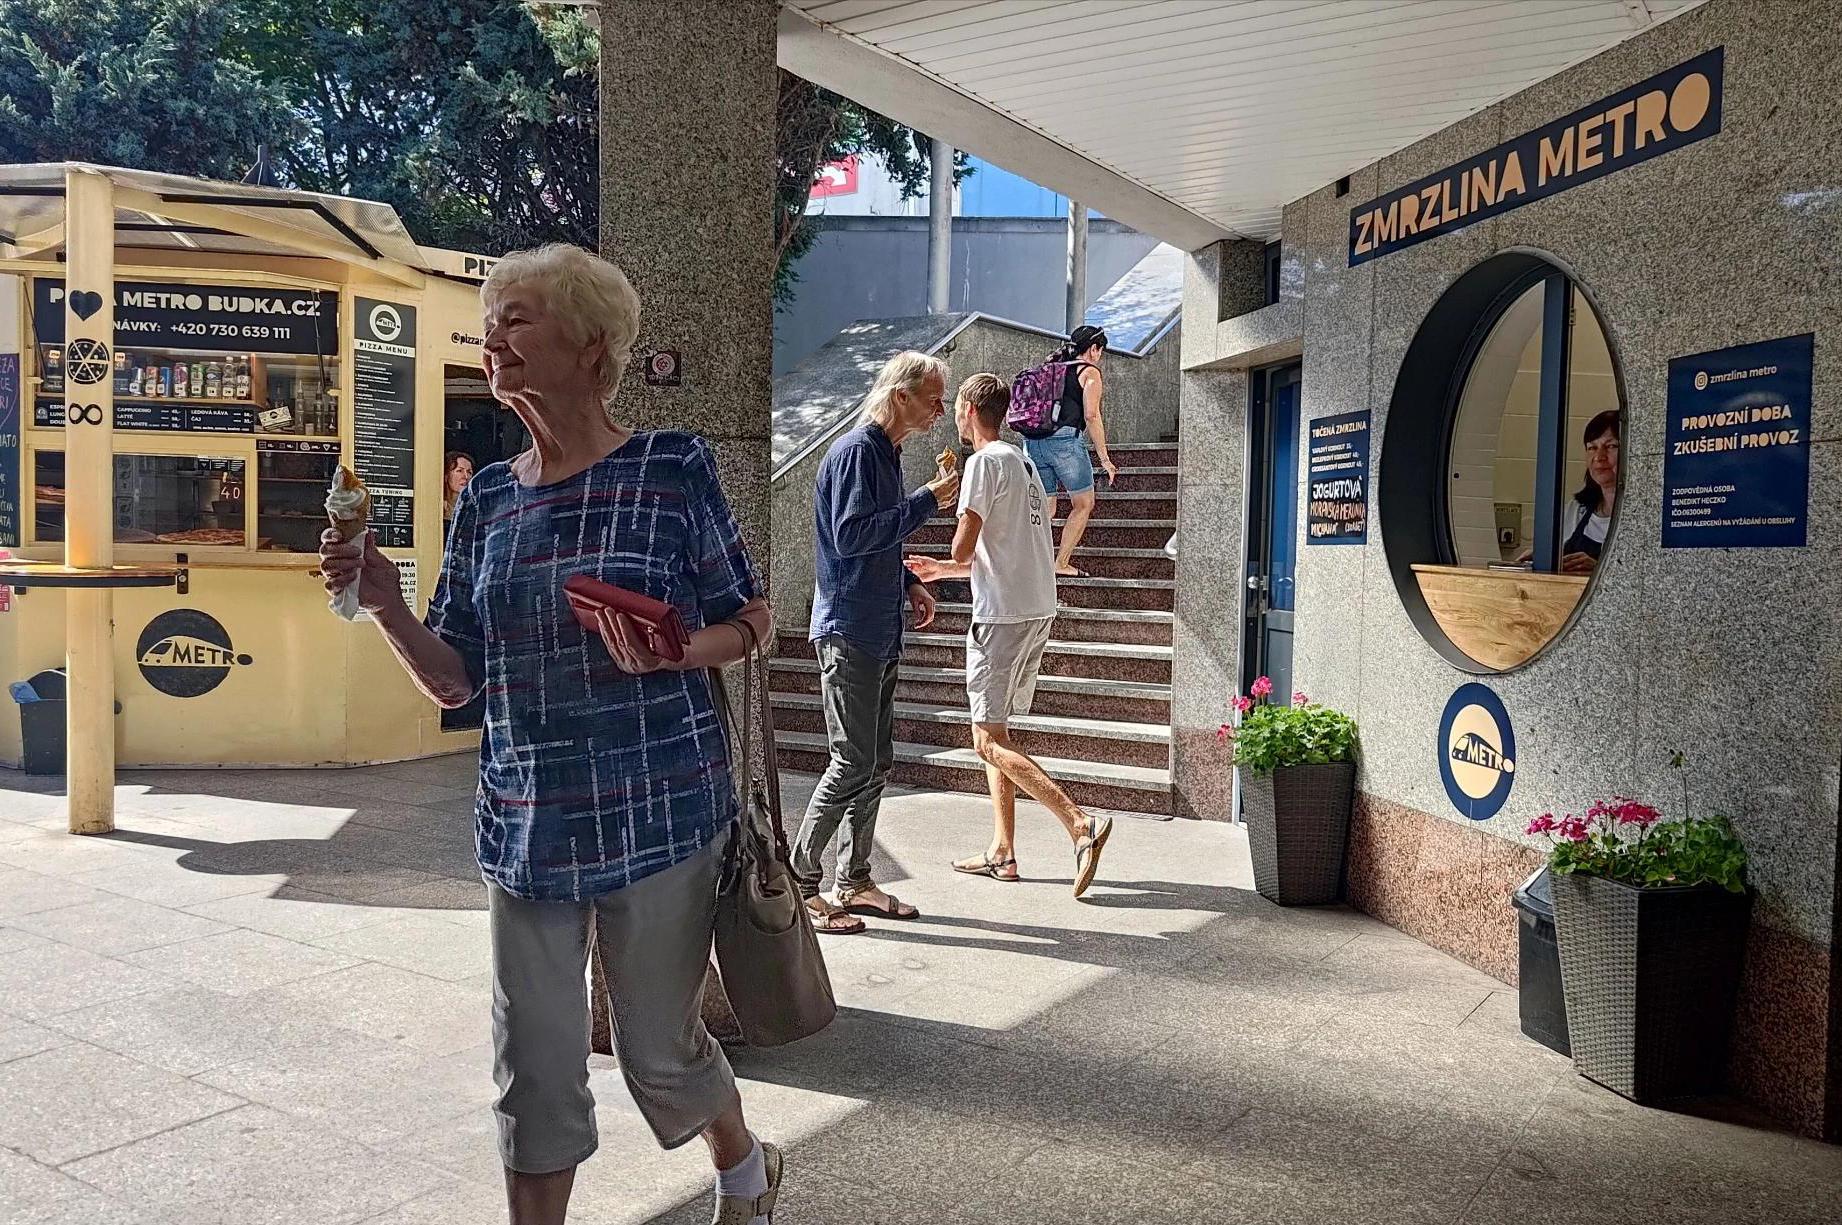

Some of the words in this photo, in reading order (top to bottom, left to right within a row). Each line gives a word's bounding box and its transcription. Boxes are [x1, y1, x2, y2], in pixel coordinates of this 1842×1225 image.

[1354, 150, 1527, 256] ZMRZLINA
[1537, 72, 1711, 187] METRO
[464, 256, 498, 277] PIZ
[122, 291, 203, 311] METRO
[208, 295, 321, 317] BUDKA.CZ
[112, 319, 161, 332] NÁVKY:
[170, 322, 207, 335] +420
[210, 324, 239, 337] 730
[242, 326, 270, 338] 639
[272, 327, 291, 339] 111
[360, 341, 382, 351] PIZZA
[386, 345, 408, 354] MENU
[1710, 369, 1747, 384] zmrzlina
[1749, 365, 1777, 378] metro
[1335, 420, 1367, 435] ZMRZLINA
[1681, 406, 1749, 431] PROVOZNÍ
[1751, 404, 1792, 423] DOBA
[1673, 432, 1739, 456] ZKUŠEBNÍ
[1740, 429, 1800, 449] PROVOZ
[1312, 475, 1362, 500] JOGURTOVÁ
[1672, 485, 1713, 496] ZODPOVĚDNÁ
[1713, 484, 1736, 494] OSOBA
[1671, 497, 1700, 506] BENEDIKT
[1701, 496, 1727, 505] HECZKO
[1670, 520, 1693, 528] SEZNAM
[1731, 516, 1761, 526] VYŽÁDÁNÍ
[1767, 517, 1796, 525] OBSLUHY
[172, 641, 253, 665] METRO
[1467, 737, 1515, 773] METRO
